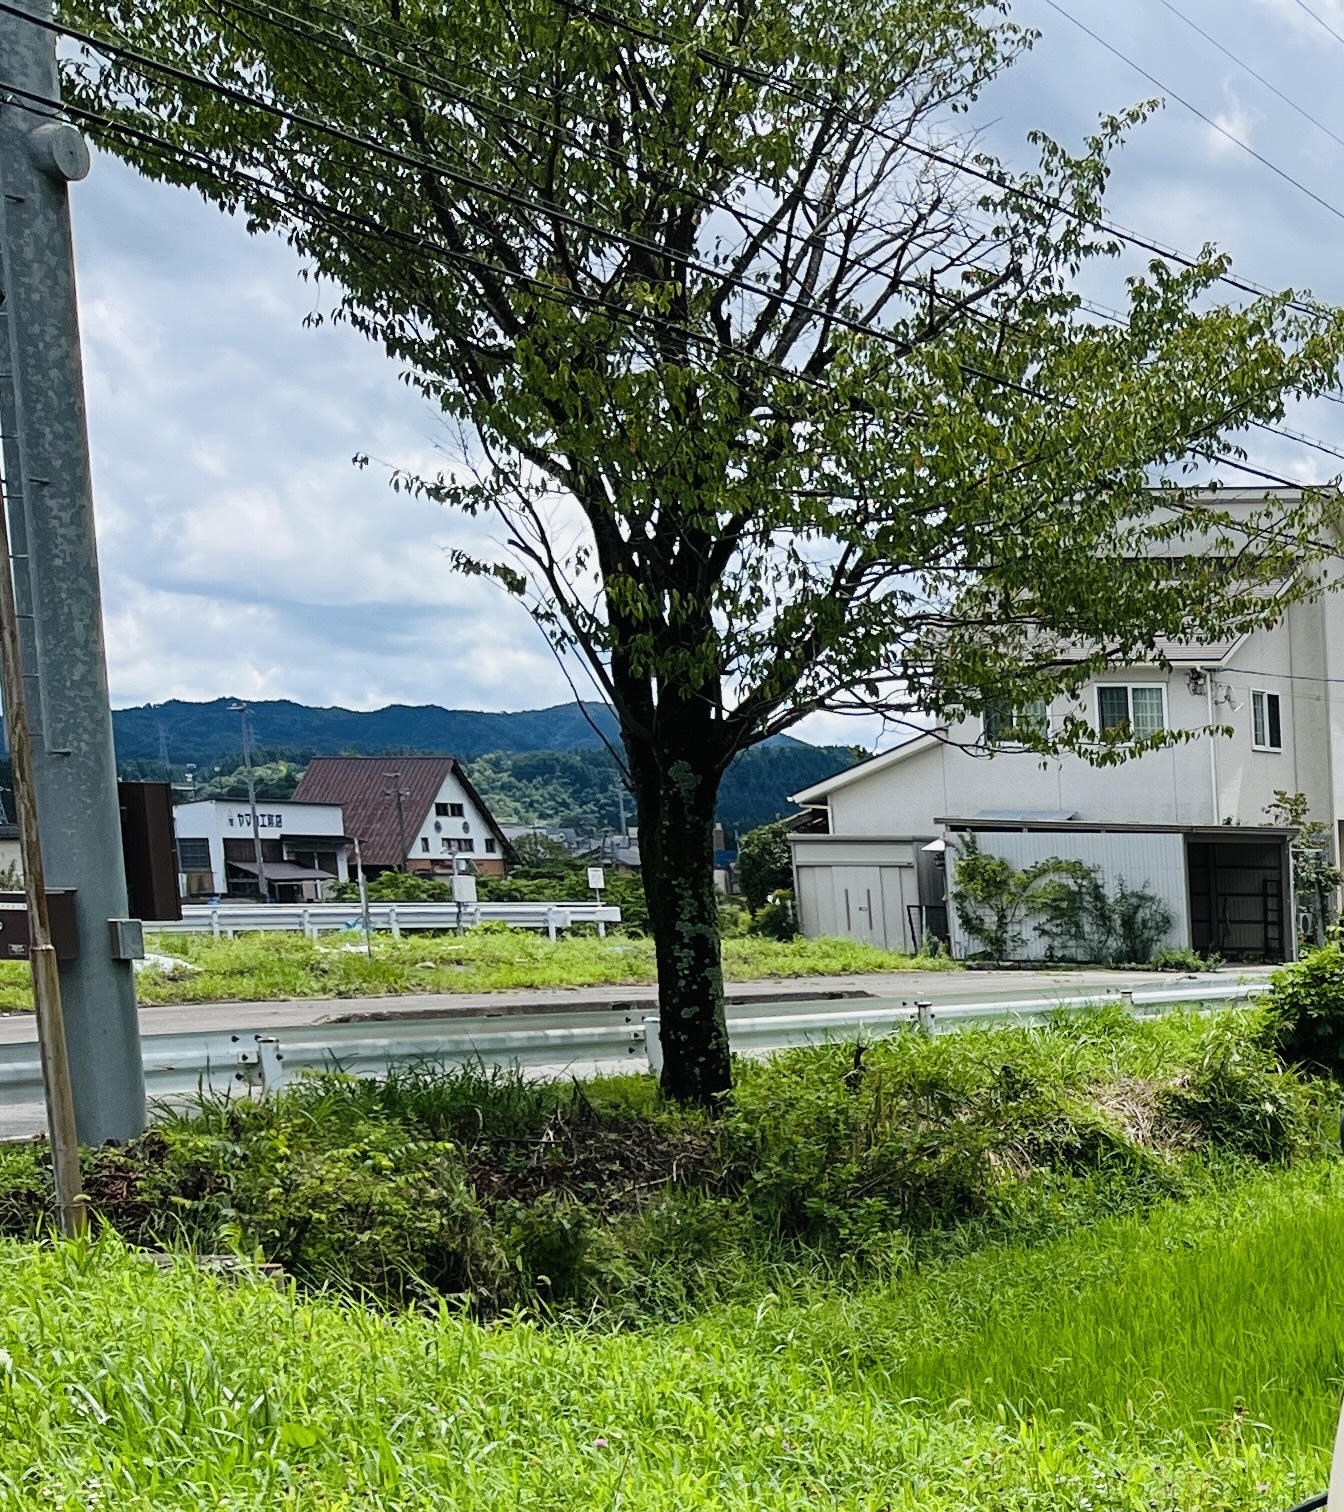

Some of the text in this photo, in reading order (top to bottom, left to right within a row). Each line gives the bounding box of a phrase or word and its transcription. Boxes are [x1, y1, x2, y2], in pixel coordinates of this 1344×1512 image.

[237, 813, 282, 828] ヤマ工務店
